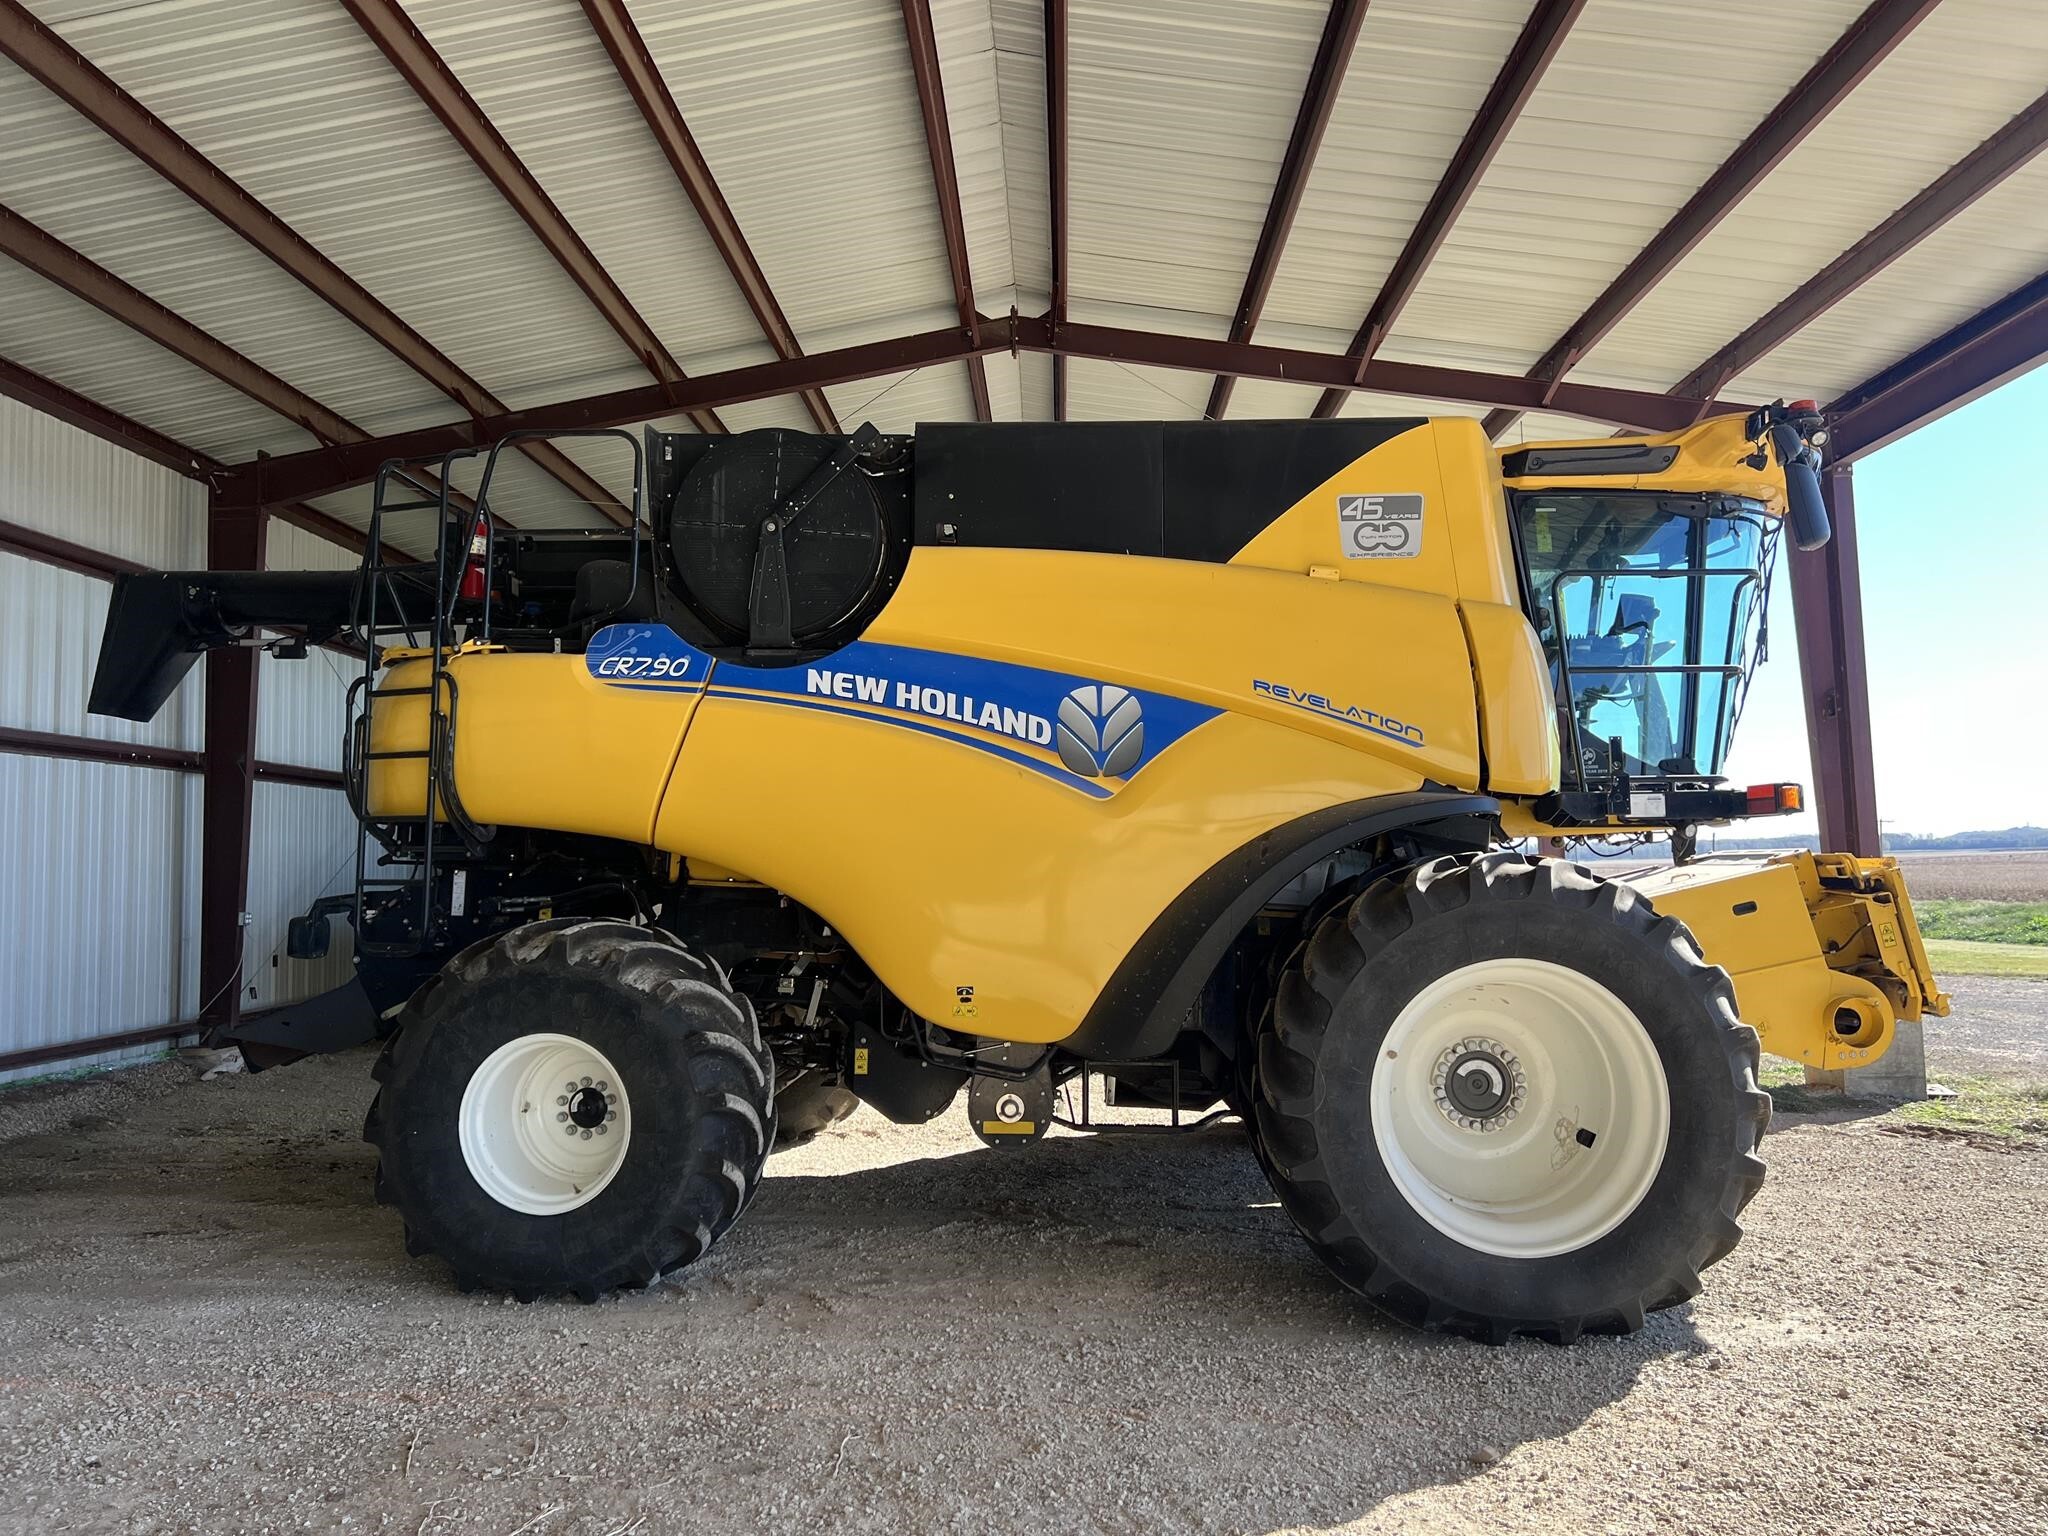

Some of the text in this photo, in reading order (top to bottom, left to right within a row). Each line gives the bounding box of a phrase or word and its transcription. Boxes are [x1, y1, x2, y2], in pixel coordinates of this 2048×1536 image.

[1341, 497, 1385, 520] 45
[598, 657, 691, 677] CR7.90
[807, 668, 1053, 746] NEW HOLLAND
[1252, 679, 1424, 742] REVELATION
